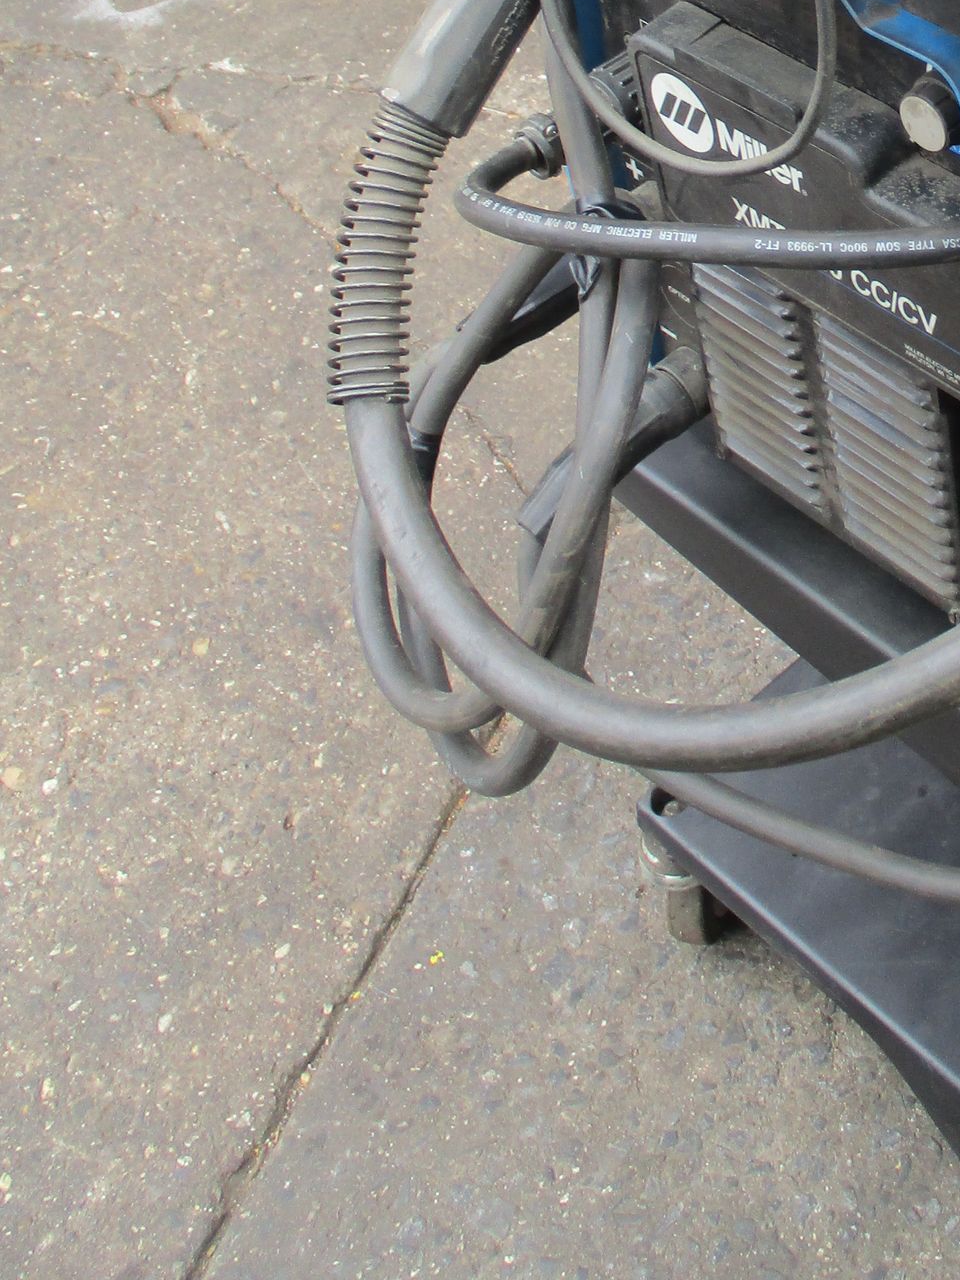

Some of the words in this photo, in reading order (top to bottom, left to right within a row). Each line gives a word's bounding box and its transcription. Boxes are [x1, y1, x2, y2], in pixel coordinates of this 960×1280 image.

[580, 223, 601, 234] MFG
[606, 225, 653, 240] ELECTRIC
[658, 229, 698, 243] MILLER
[754, 238, 780, 251] FT-2
[787, 240, 833, 253] LL-9993
[875, 240, 901, 252] SOW
[908, 238, 935, 251] TYPE
[851, 269, 938, 336] CC/CV
